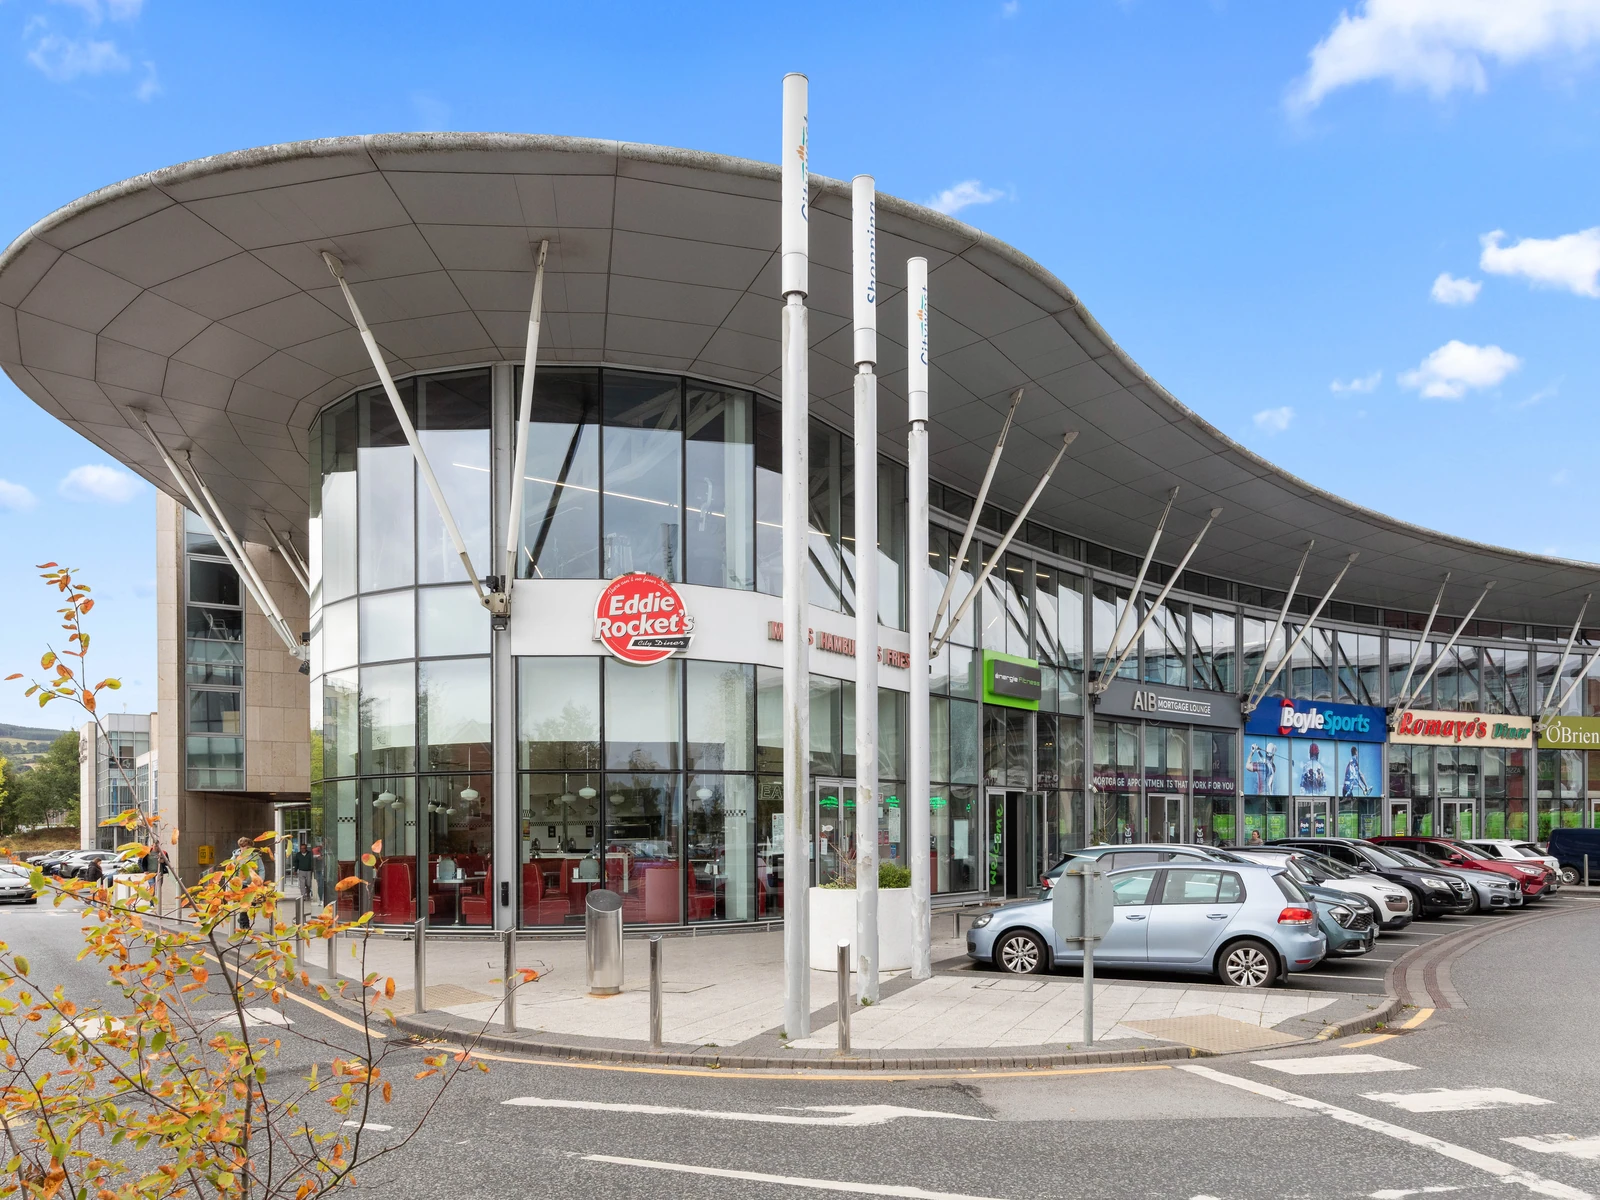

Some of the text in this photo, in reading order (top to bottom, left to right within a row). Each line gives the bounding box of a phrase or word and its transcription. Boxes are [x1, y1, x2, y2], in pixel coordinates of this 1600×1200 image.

[608, 591, 676, 617] Eddie
[594, 609, 695, 639] Rocket's
[637, 639, 652, 648] City
[884, 648, 910, 669] FRIES
[1133, 690, 1211, 714] AIB MORTGAGE LOUNGE
[1397, 712, 1531, 743] Romayo's Diner
[760, 784, 784, 800] EA
[1093, 776, 1125, 787] MORTGAGE
[1174, 779, 1189, 789] THAT
[1222, 781, 1234, 791] YOU
